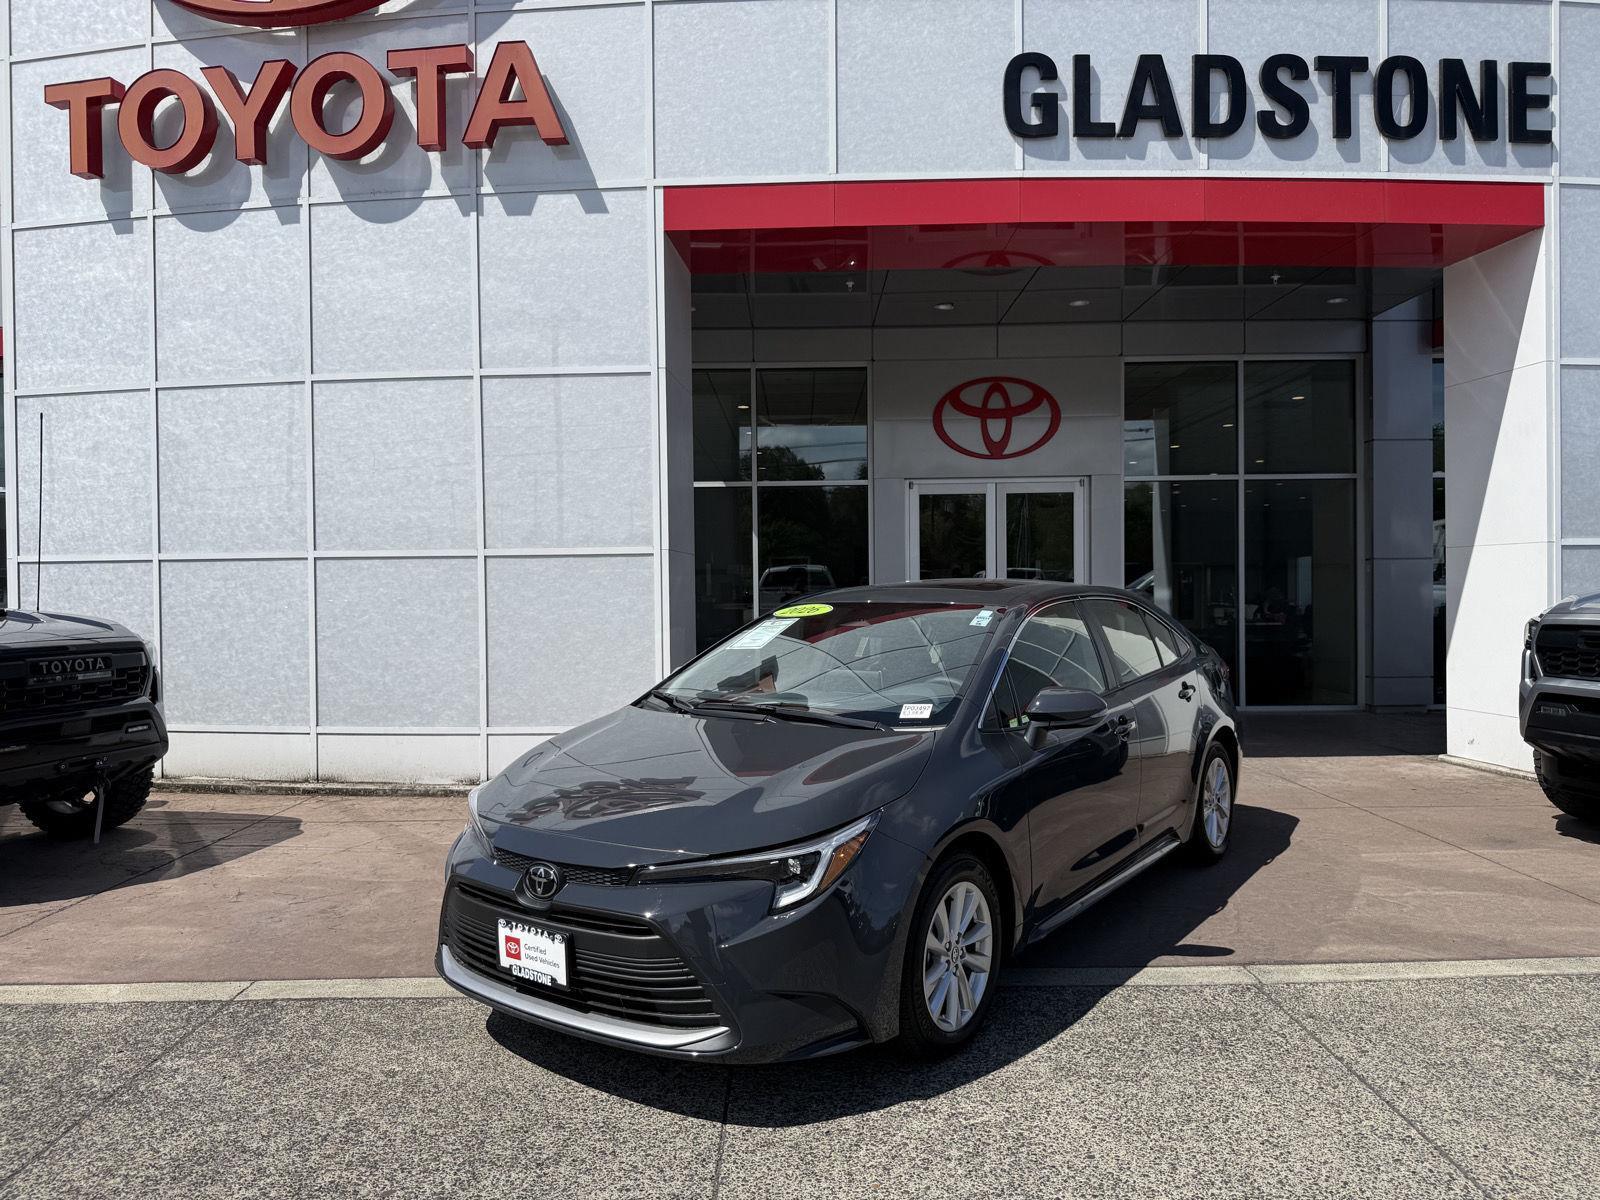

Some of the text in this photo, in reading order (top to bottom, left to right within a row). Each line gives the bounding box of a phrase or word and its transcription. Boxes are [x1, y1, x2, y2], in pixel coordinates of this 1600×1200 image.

[1002, 52, 1554, 145] GLADSTONE
[44, 40, 570, 180] TOYOTA
[39, 657, 105, 674] TOYOTA
[512, 922, 549, 938] TOYOTA
[524, 944, 546, 955] Certified
[525, 953, 560, 968] Used Vehicles
[512, 964, 552, 986] GLADSTONE
